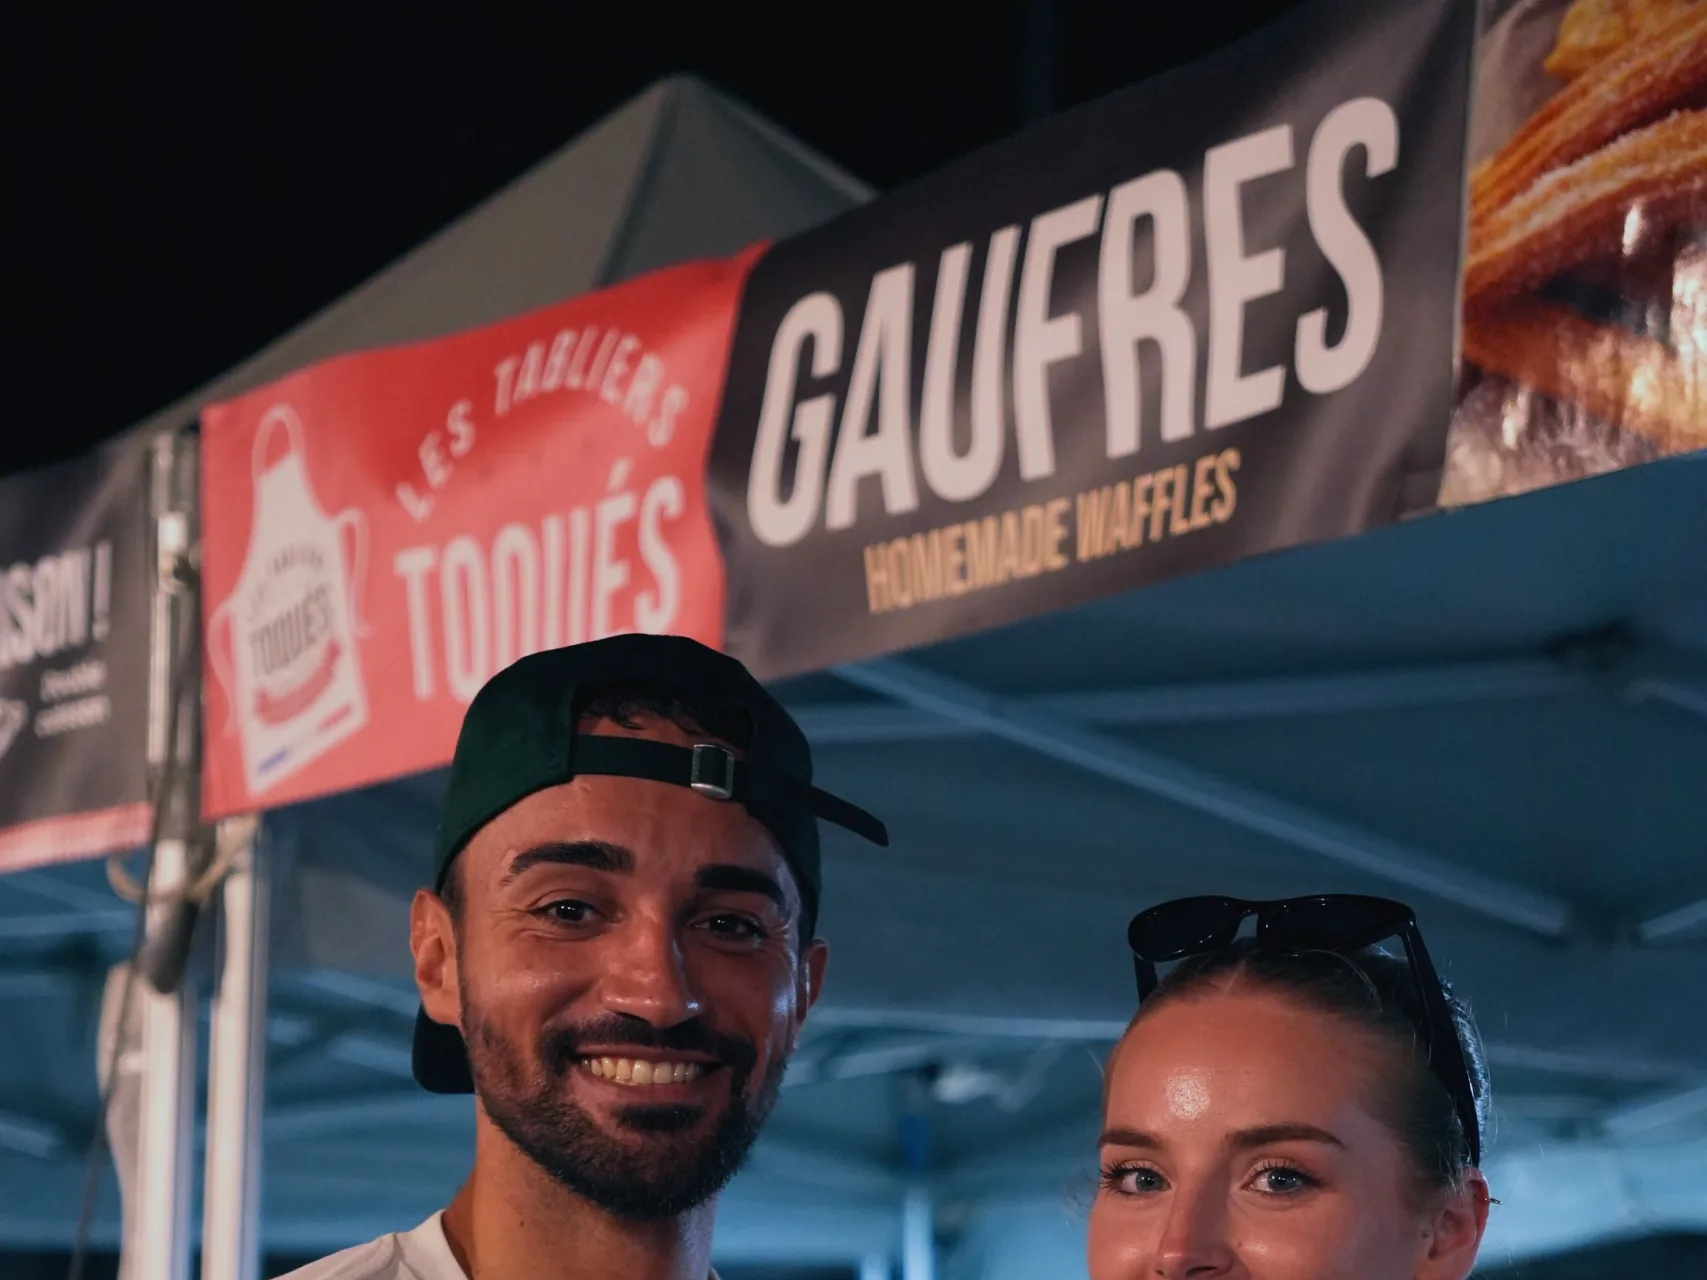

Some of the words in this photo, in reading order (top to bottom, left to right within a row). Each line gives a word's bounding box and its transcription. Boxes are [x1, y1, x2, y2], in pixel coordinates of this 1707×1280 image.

[748, 97, 1399, 547] GAUFRES
[396, 399, 477, 521] LES
[494, 326, 689, 447] TABLIERS
[866, 502, 1068, 612] HOMEMADE
[1077, 449, 1239, 564] WAFFLES
